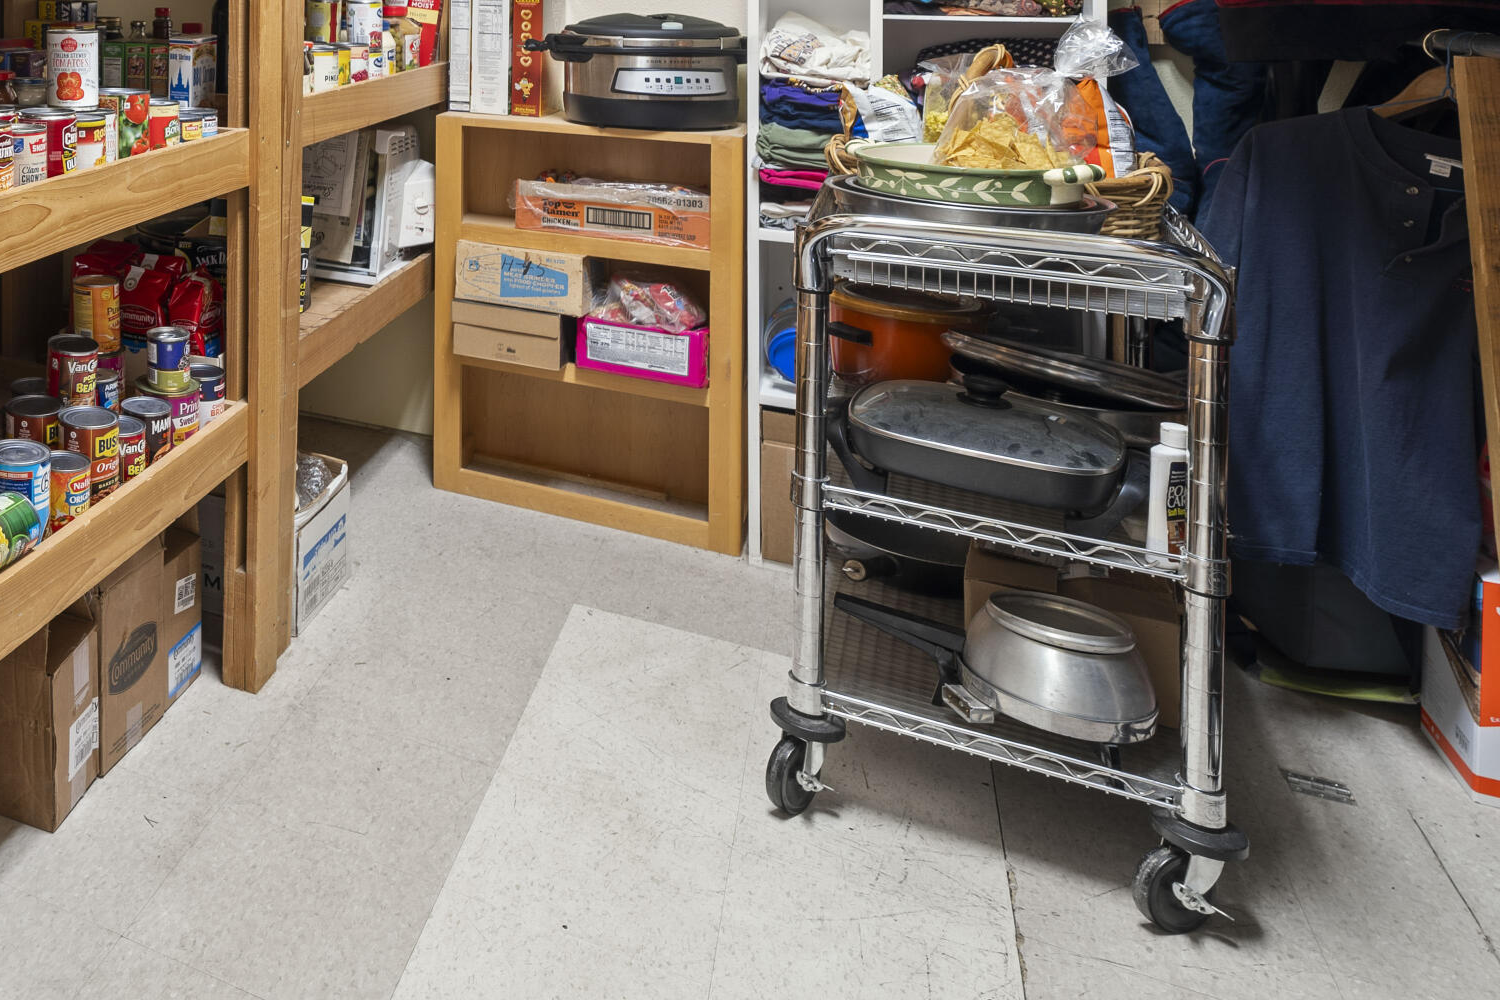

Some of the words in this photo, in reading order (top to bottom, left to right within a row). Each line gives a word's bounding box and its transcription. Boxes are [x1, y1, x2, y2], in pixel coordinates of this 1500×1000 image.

[411, 1, 435, 9] MOIST
[52, 58, 90, 68] TOMATOES
[21, 165, 40, 174] Clam
[542, 199, 562, 209] Top
[542, 207, 580, 218] Ramen
[542, 217, 571, 227] CHICKEN
[108, 630, 156, 687] Community
